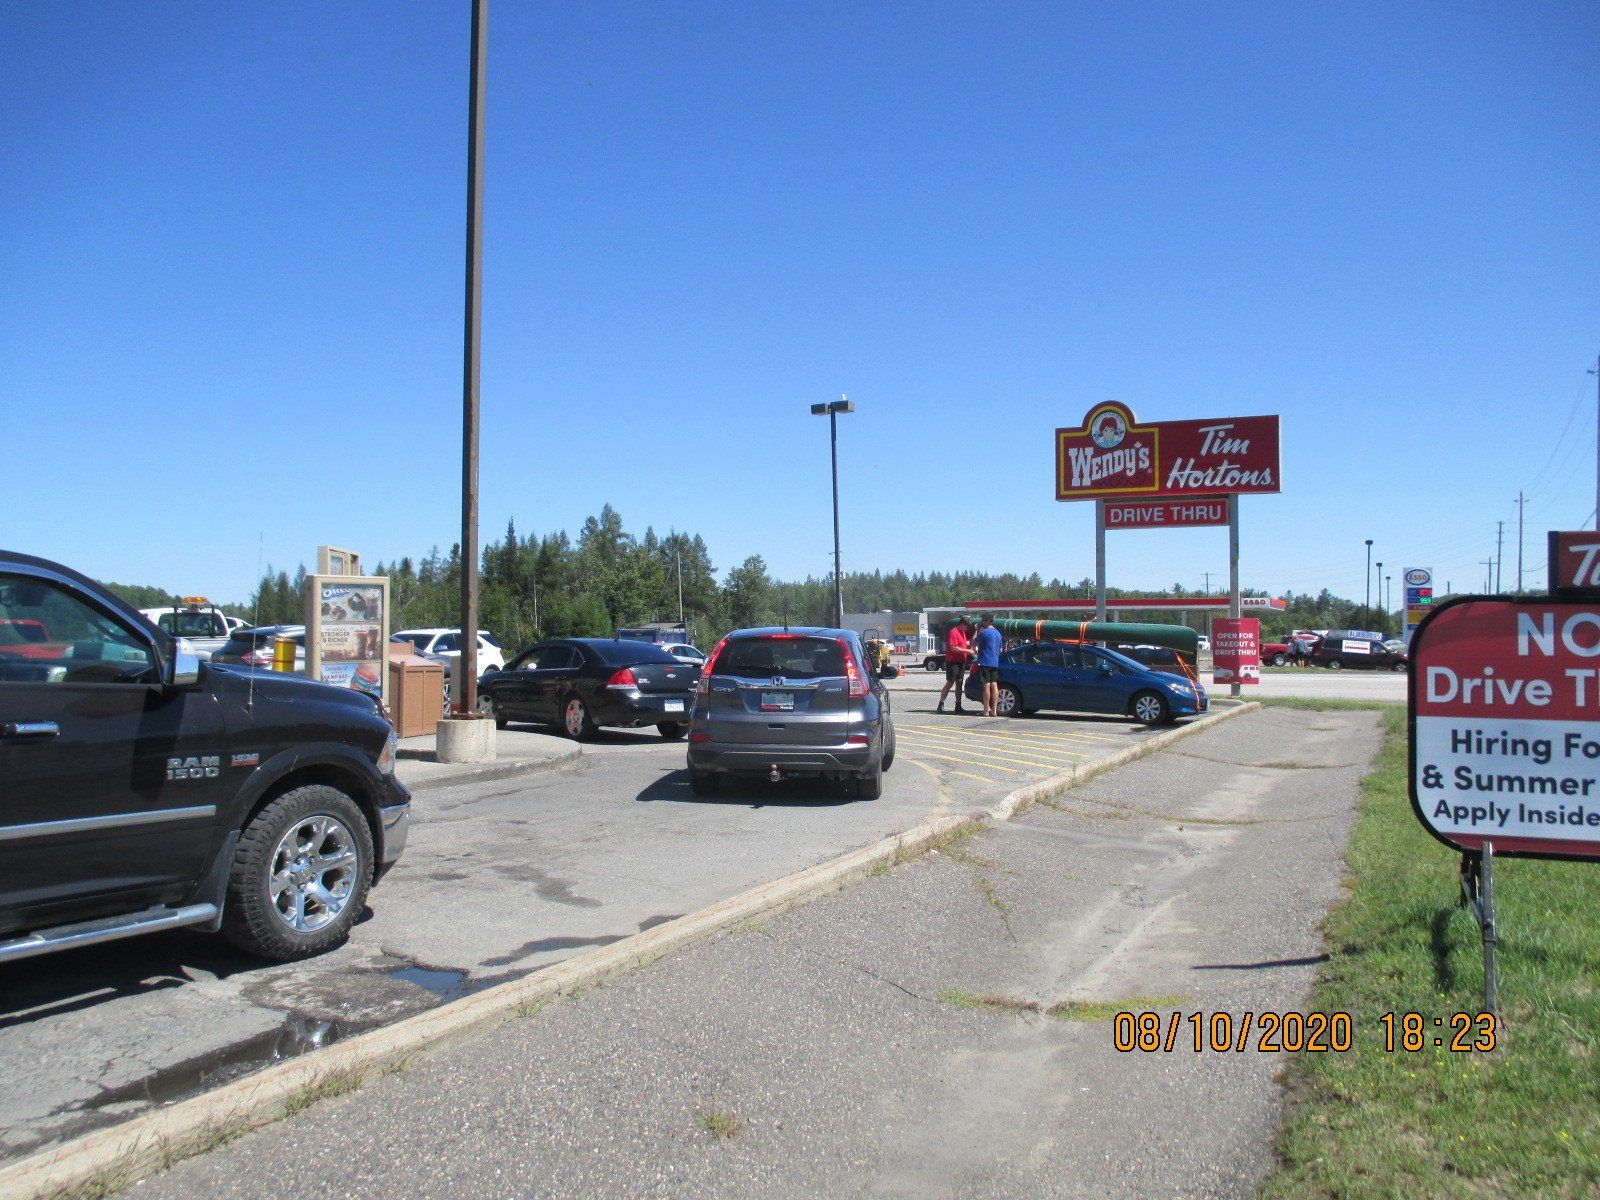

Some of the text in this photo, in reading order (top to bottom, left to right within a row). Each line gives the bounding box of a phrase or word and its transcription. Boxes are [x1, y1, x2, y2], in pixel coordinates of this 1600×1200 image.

[1199, 424, 1250, 456] Tim
[1068, 441, 1150, 487] Wendy's
[1166, 457, 1272, 489] Hortons
[1110, 505, 1222, 523] DRIVE THRU
[1426, 666, 1600, 708] Drive T
[166, 755, 220, 769] RAM
[1451, 729, 1551, 764] Hiring
[166, 767, 220, 781] 1500
[1421, 764, 1596, 796] & Summer
[1433, 799, 1600, 828] Apply Inside
